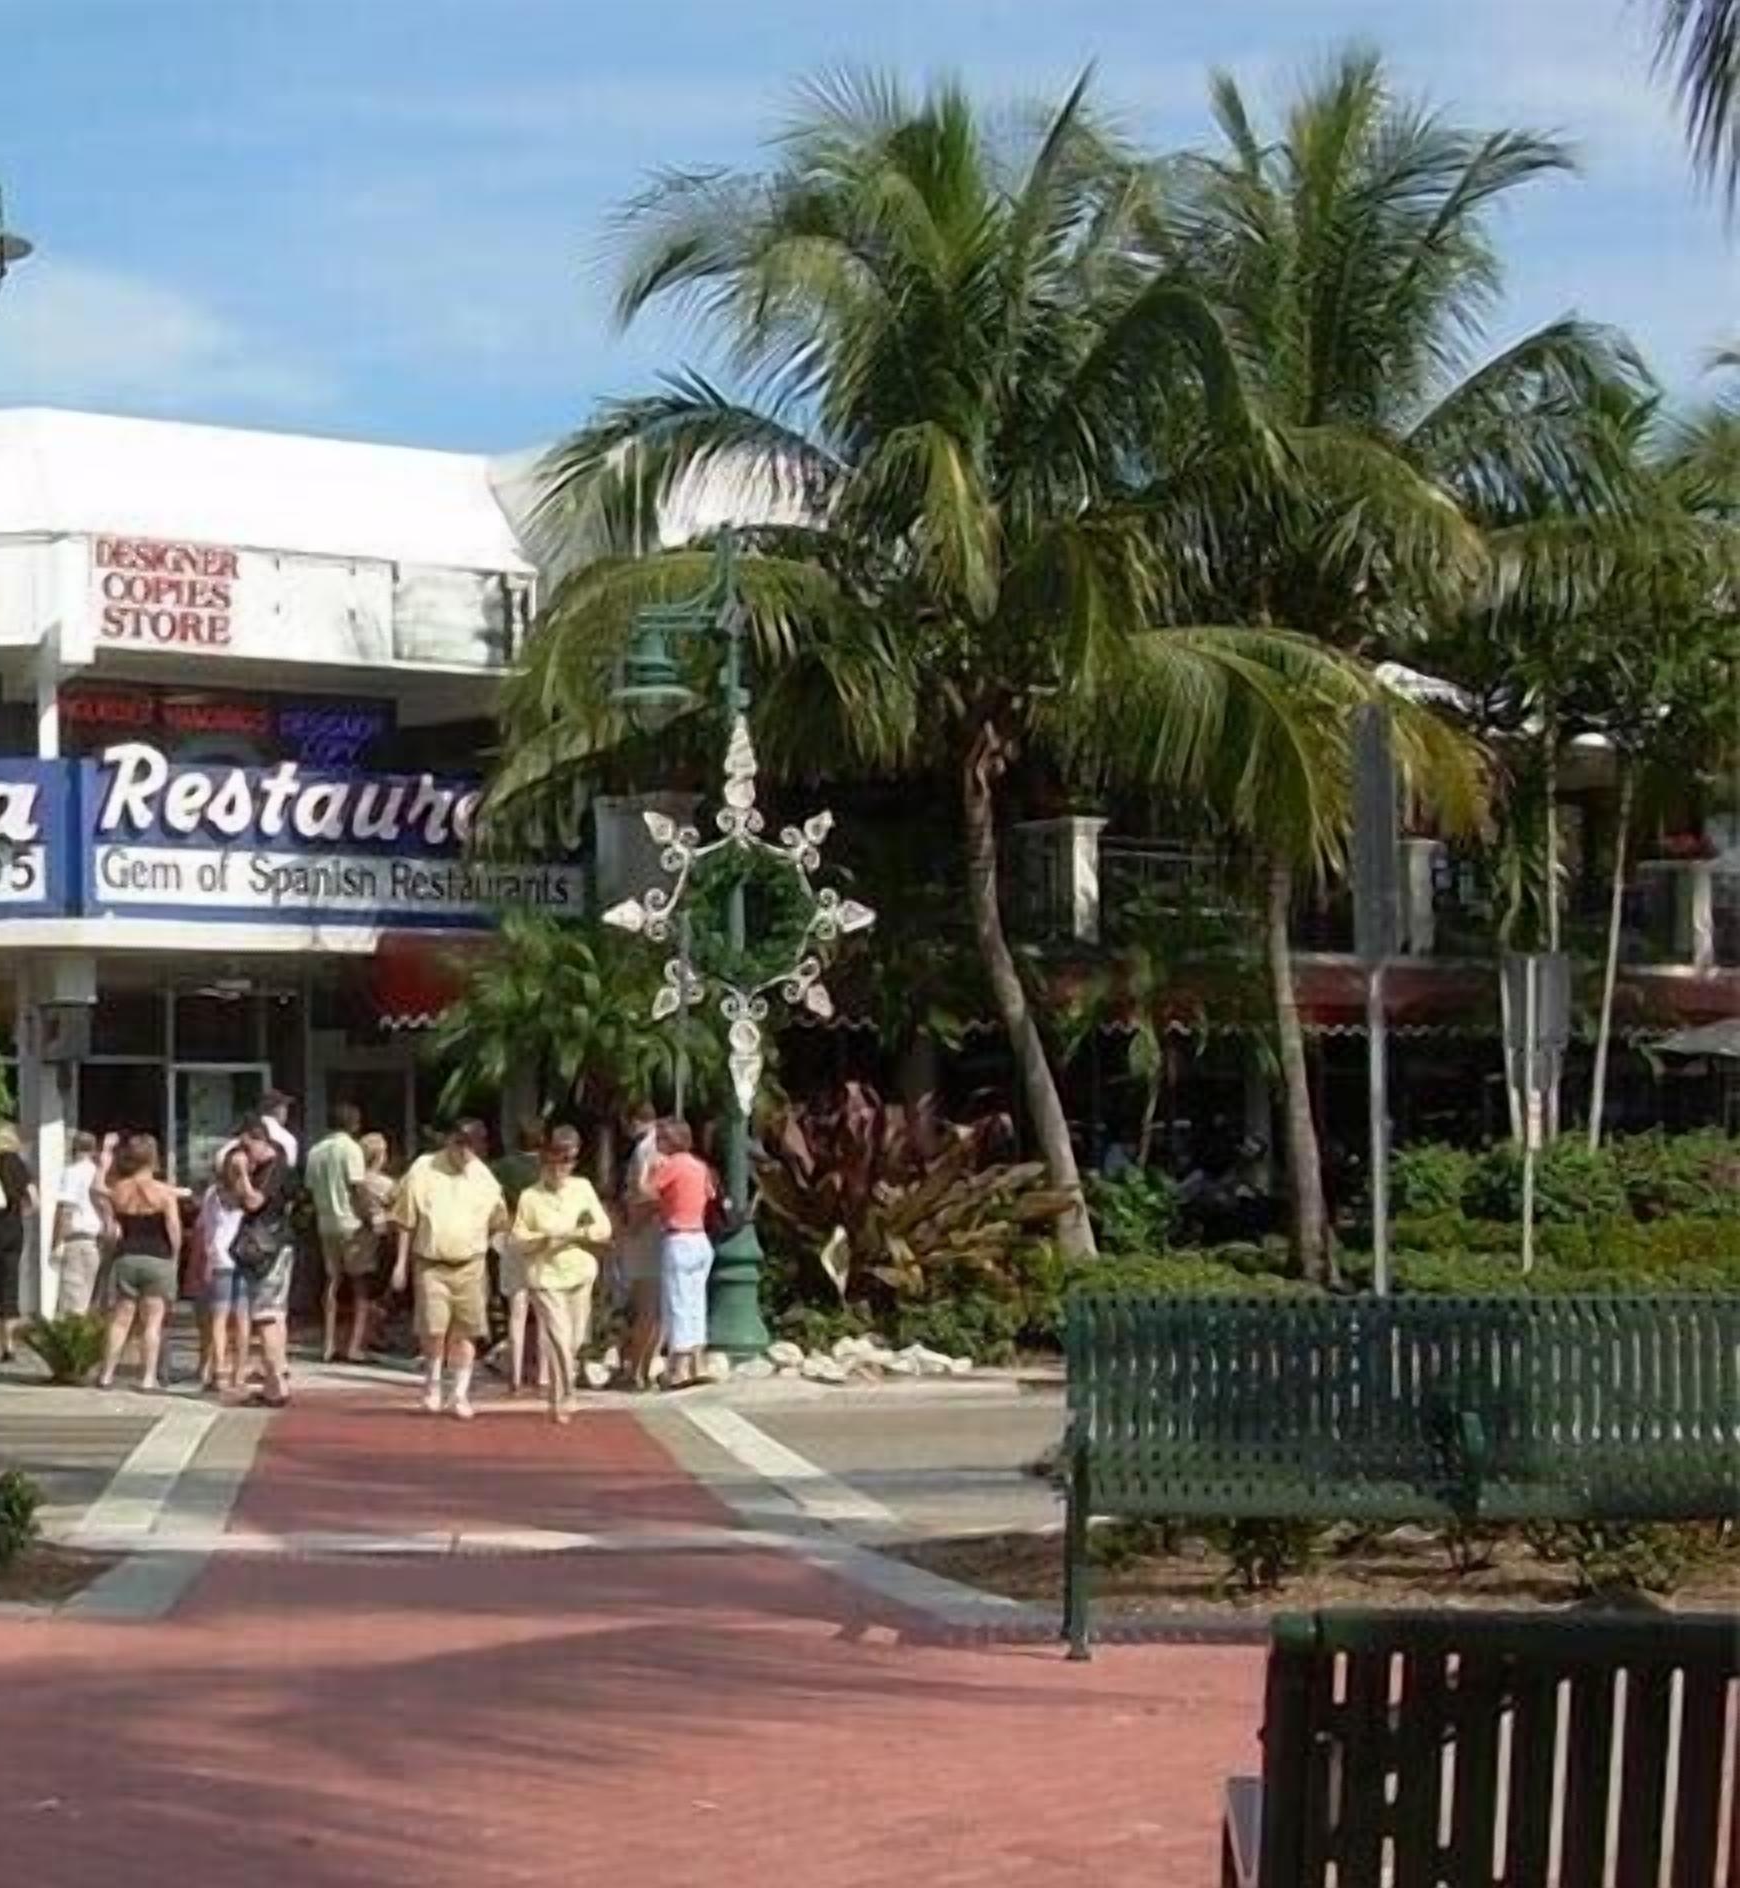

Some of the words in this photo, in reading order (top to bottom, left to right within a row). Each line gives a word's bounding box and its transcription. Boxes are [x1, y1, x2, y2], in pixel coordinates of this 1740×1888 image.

[95, 538, 239, 580] DESIGNER
[102, 571, 232, 609] COPIES
[100, 604, 233, 645] STORE
[100, 742, 585, 850] Restaur
[101, 845, 181, 889] Gem
[197, 848, 228, 892] of
[249, 852, 377, 906] Spanish
